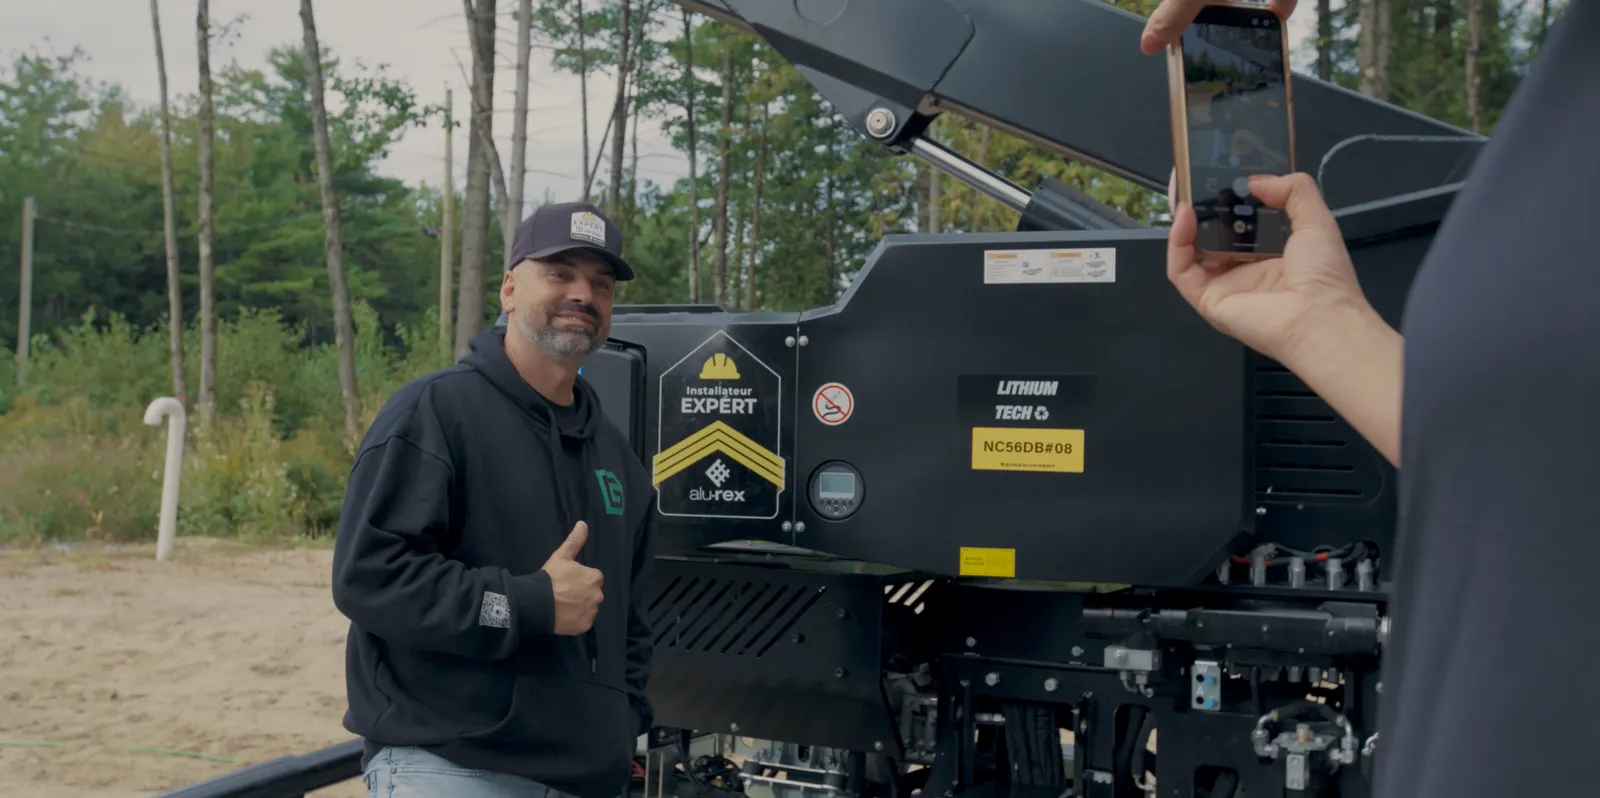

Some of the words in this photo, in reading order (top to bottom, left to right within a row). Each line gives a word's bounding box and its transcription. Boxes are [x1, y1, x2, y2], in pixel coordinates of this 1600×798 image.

[574, 220, 603, 231] EXPERT
[686, 386, 752, 396] Installateur
[997, 380, 1059, 396] LITHIUM
[681, 398, 757, 414] EXPERT
[995, 405, 1033, 420] TECH
[984, 440, 1072, 454] NC56DB#08
[689, 487, 745, 502] alu-rex
